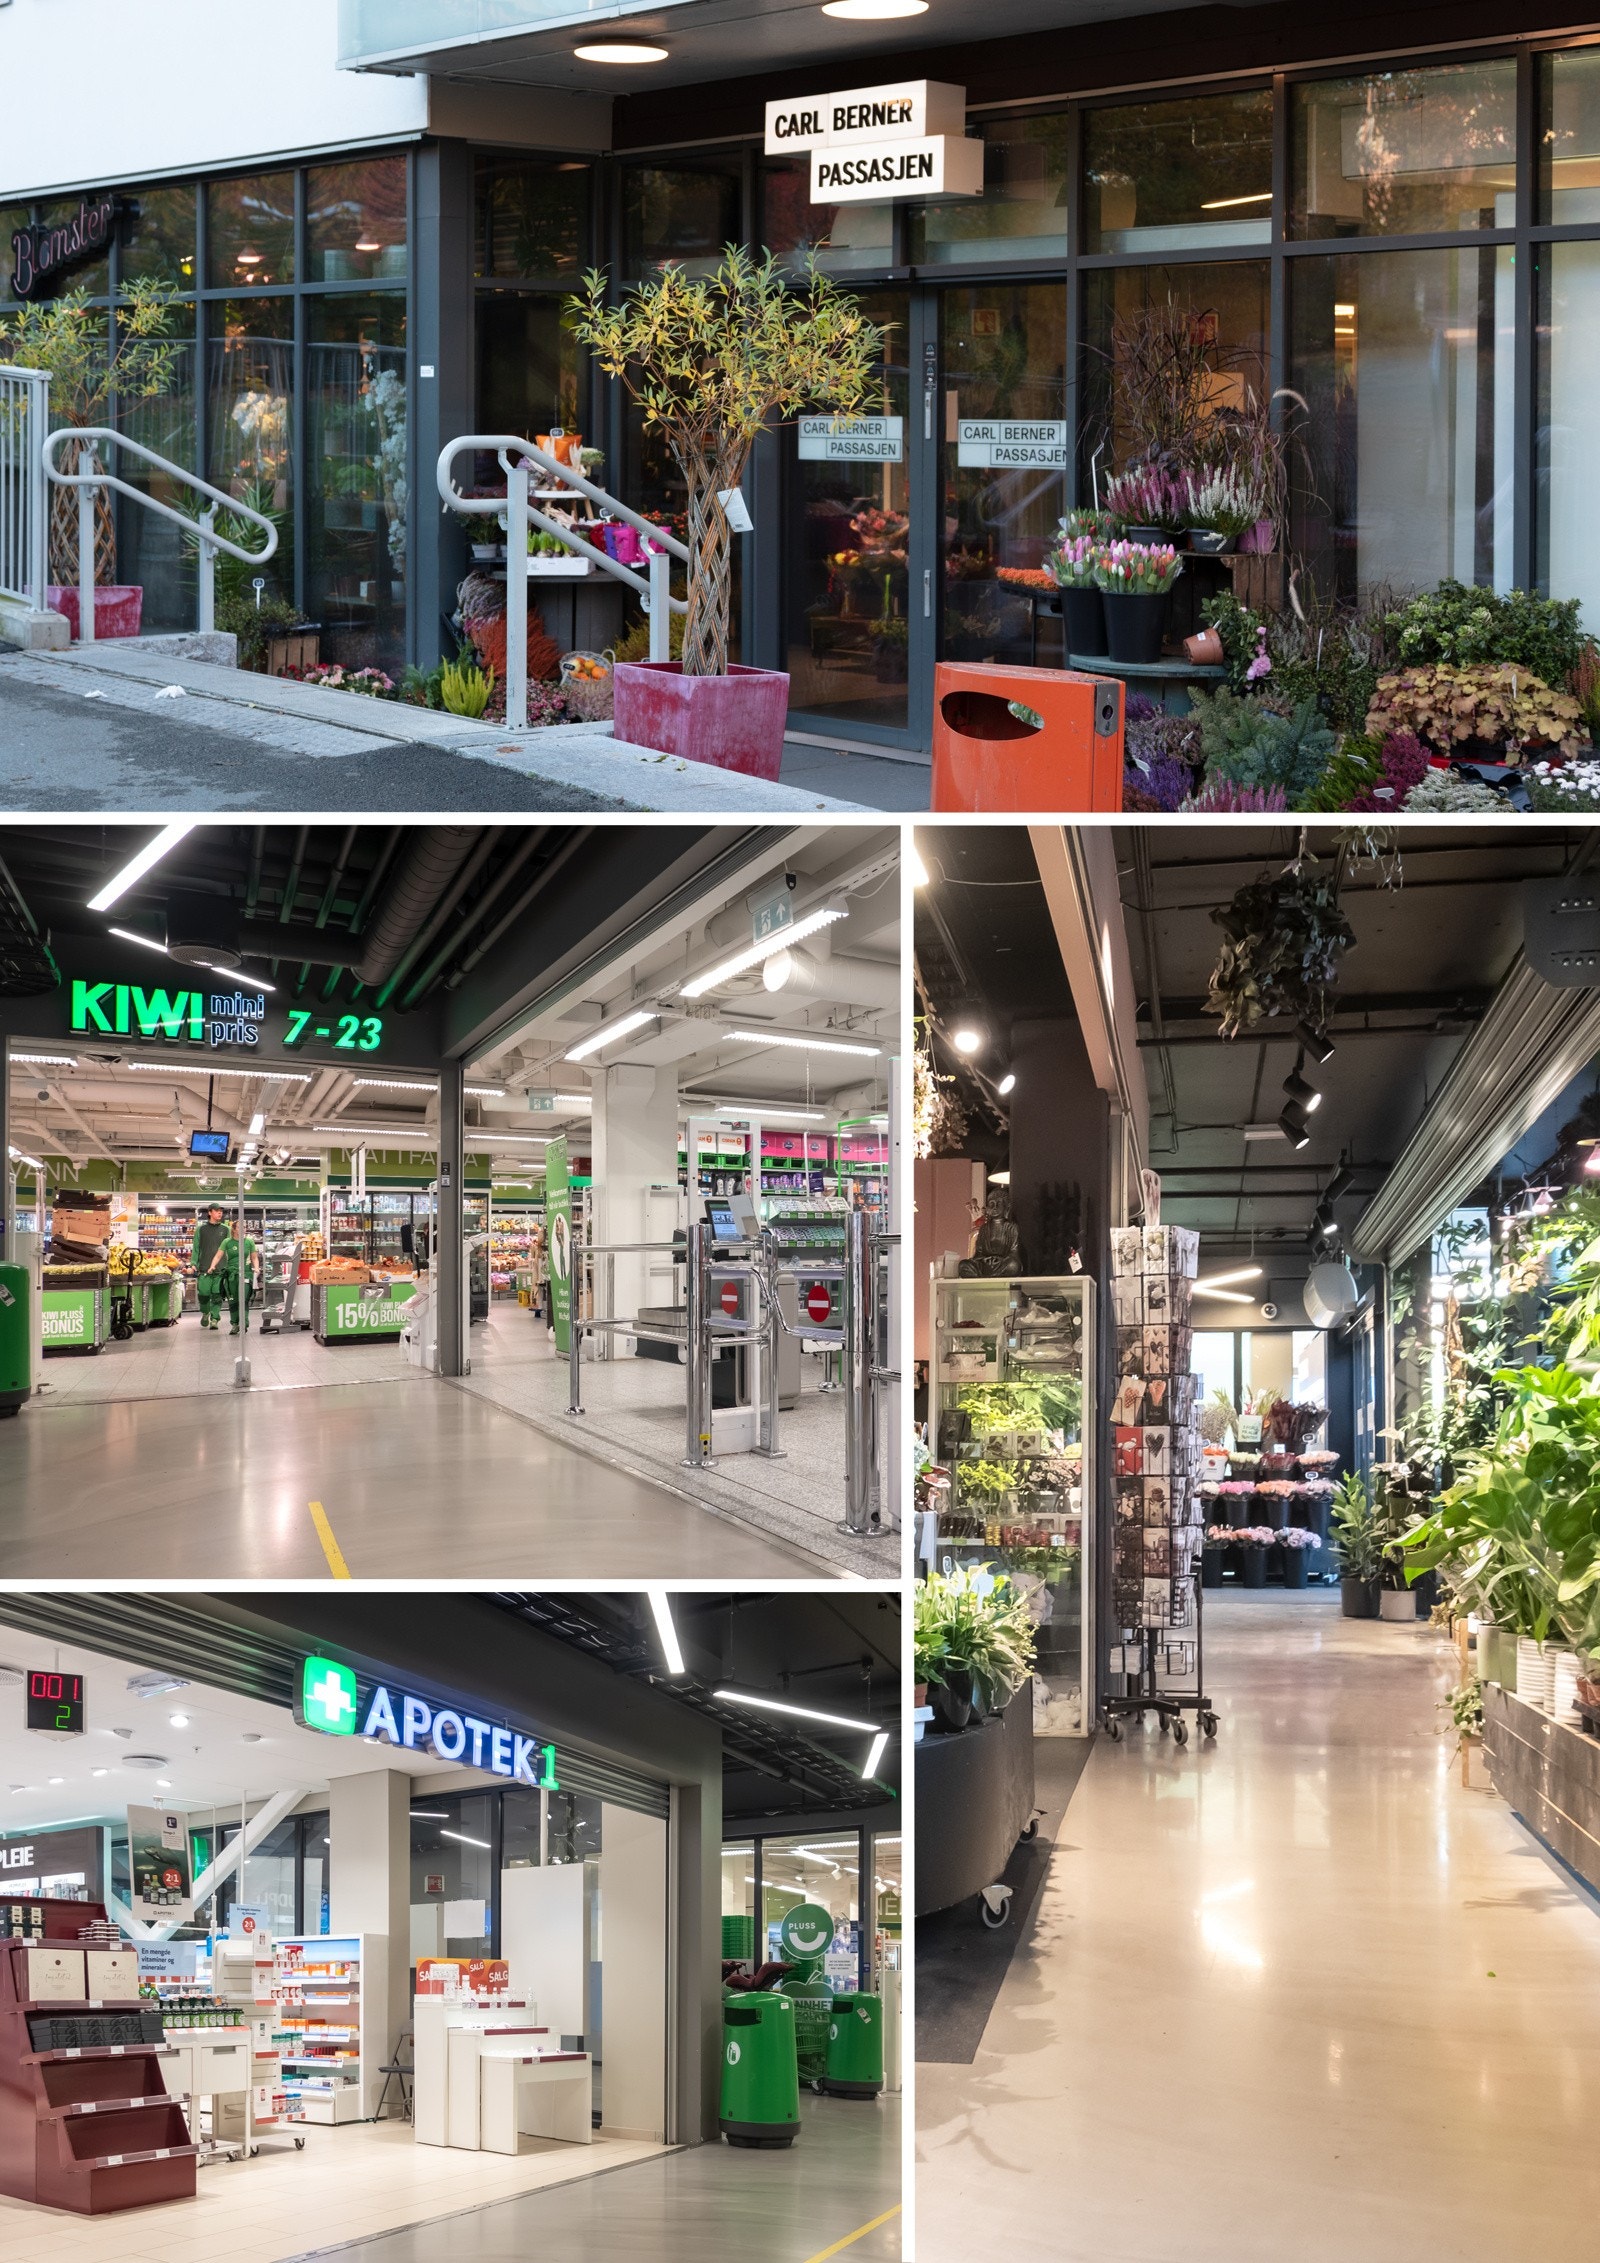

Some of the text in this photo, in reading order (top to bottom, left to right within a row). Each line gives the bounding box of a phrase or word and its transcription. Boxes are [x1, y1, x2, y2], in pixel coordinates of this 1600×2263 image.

[775, 98, 913, 138] CARL BERNER
[818, 153, 933, 188] PASSASJEN
[13, 203, 110, 294] Blomster
[803, 422, 831, 434] CARL
[964, 427, 1055, 440] CARL BERNER
[830, 442, 896, 456] PASSASJEN
[72, 980, 203, 1040] KIWI
[210, 991, 264, 1019] mini
[210, 1018, 259, 1048] pris
[42, 1310, 84, 1320] KIWI PLUSS
[335, 1302, 379, 1329] 15%
[42, 1319, 84, 1335] BONUS
[31, 1674, 78, 1699] 001
[56, 1705, 70, 1728] 2
[363, 1686, 559, 1790] APOTEK 1
[0, 1846, 34, 1869] LEIE
[788, 1922, 816, 1930] PLUSS
[469, 1962, 484, 1972] SALG
[488, 1971, 508, 1982] SALG
